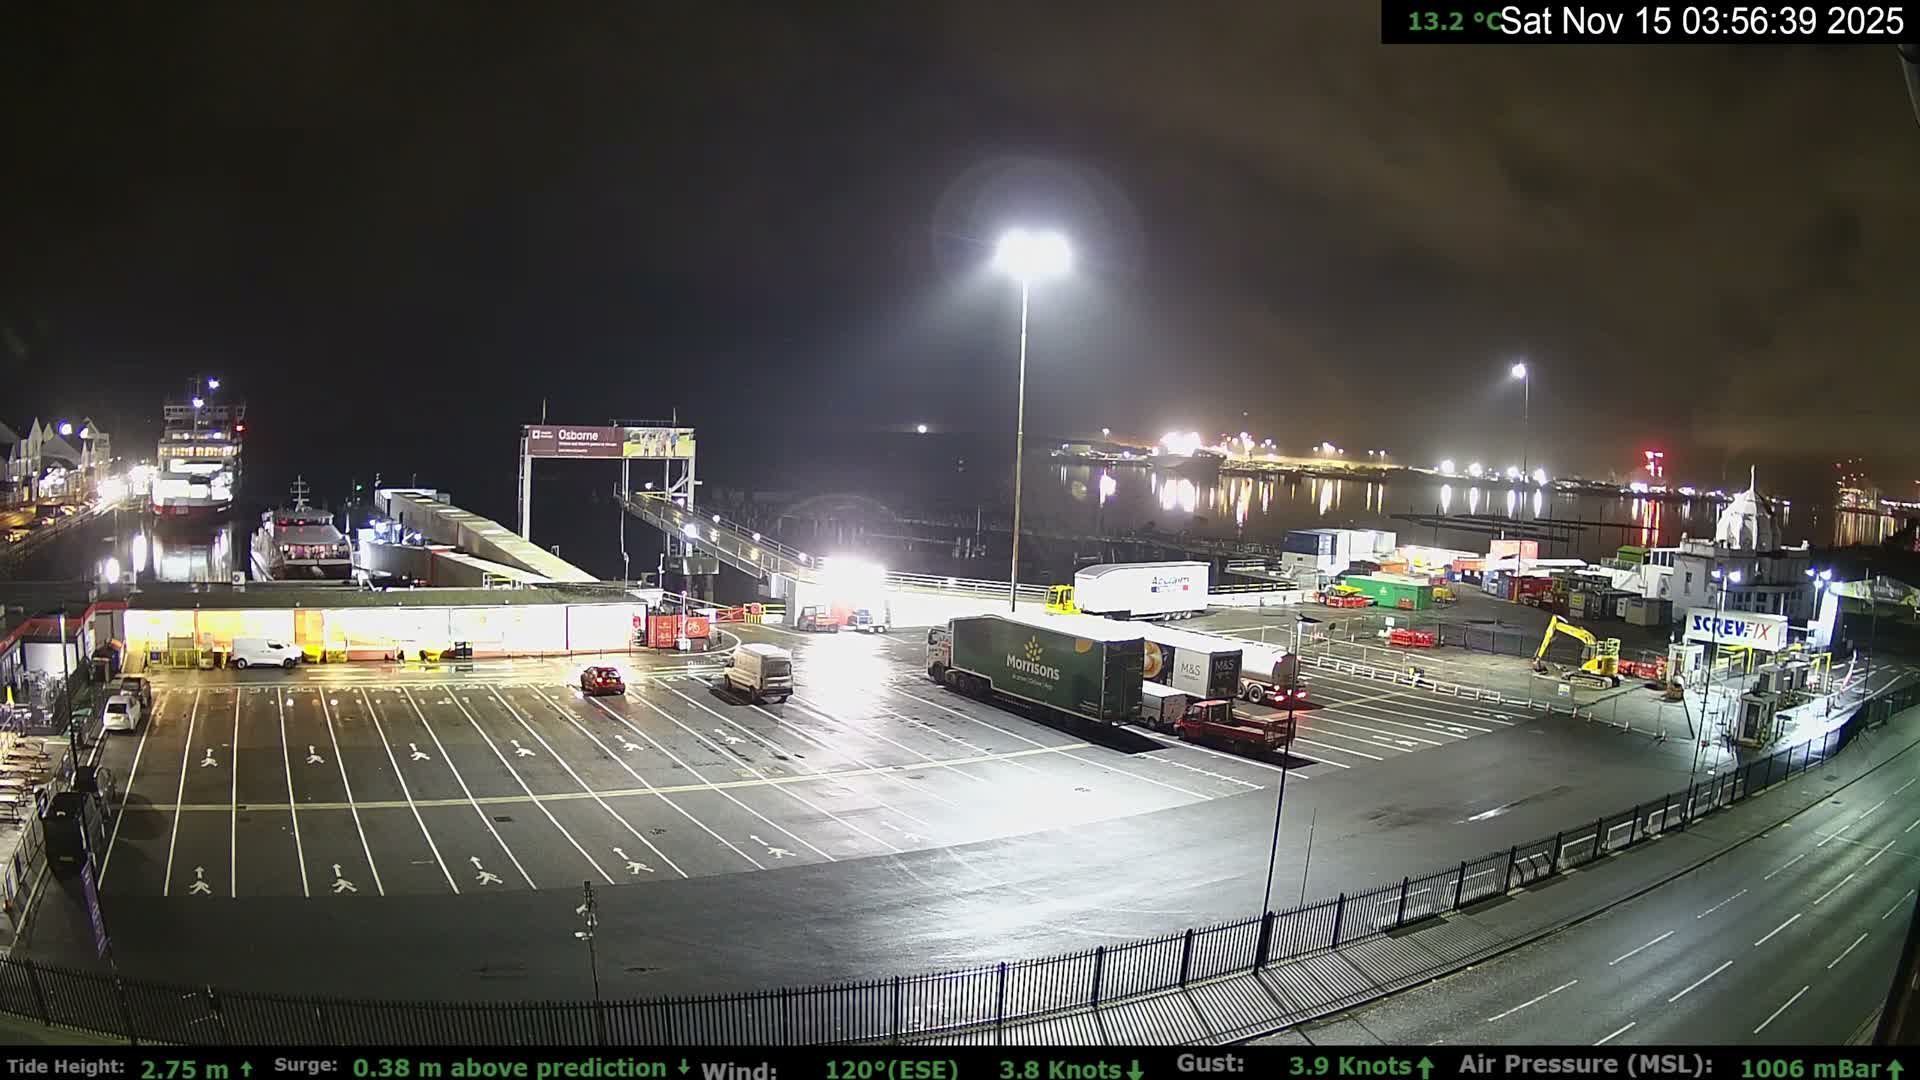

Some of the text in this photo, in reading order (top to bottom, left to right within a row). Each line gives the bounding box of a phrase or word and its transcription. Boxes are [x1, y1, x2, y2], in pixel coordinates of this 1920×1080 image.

[558, 429, 598, 440] Osborne
[1006, 653, 1060, 680] Morrisons
[1180, 663, 1200, 676] M&S
[1215, 660, 1234, 672] M&S
